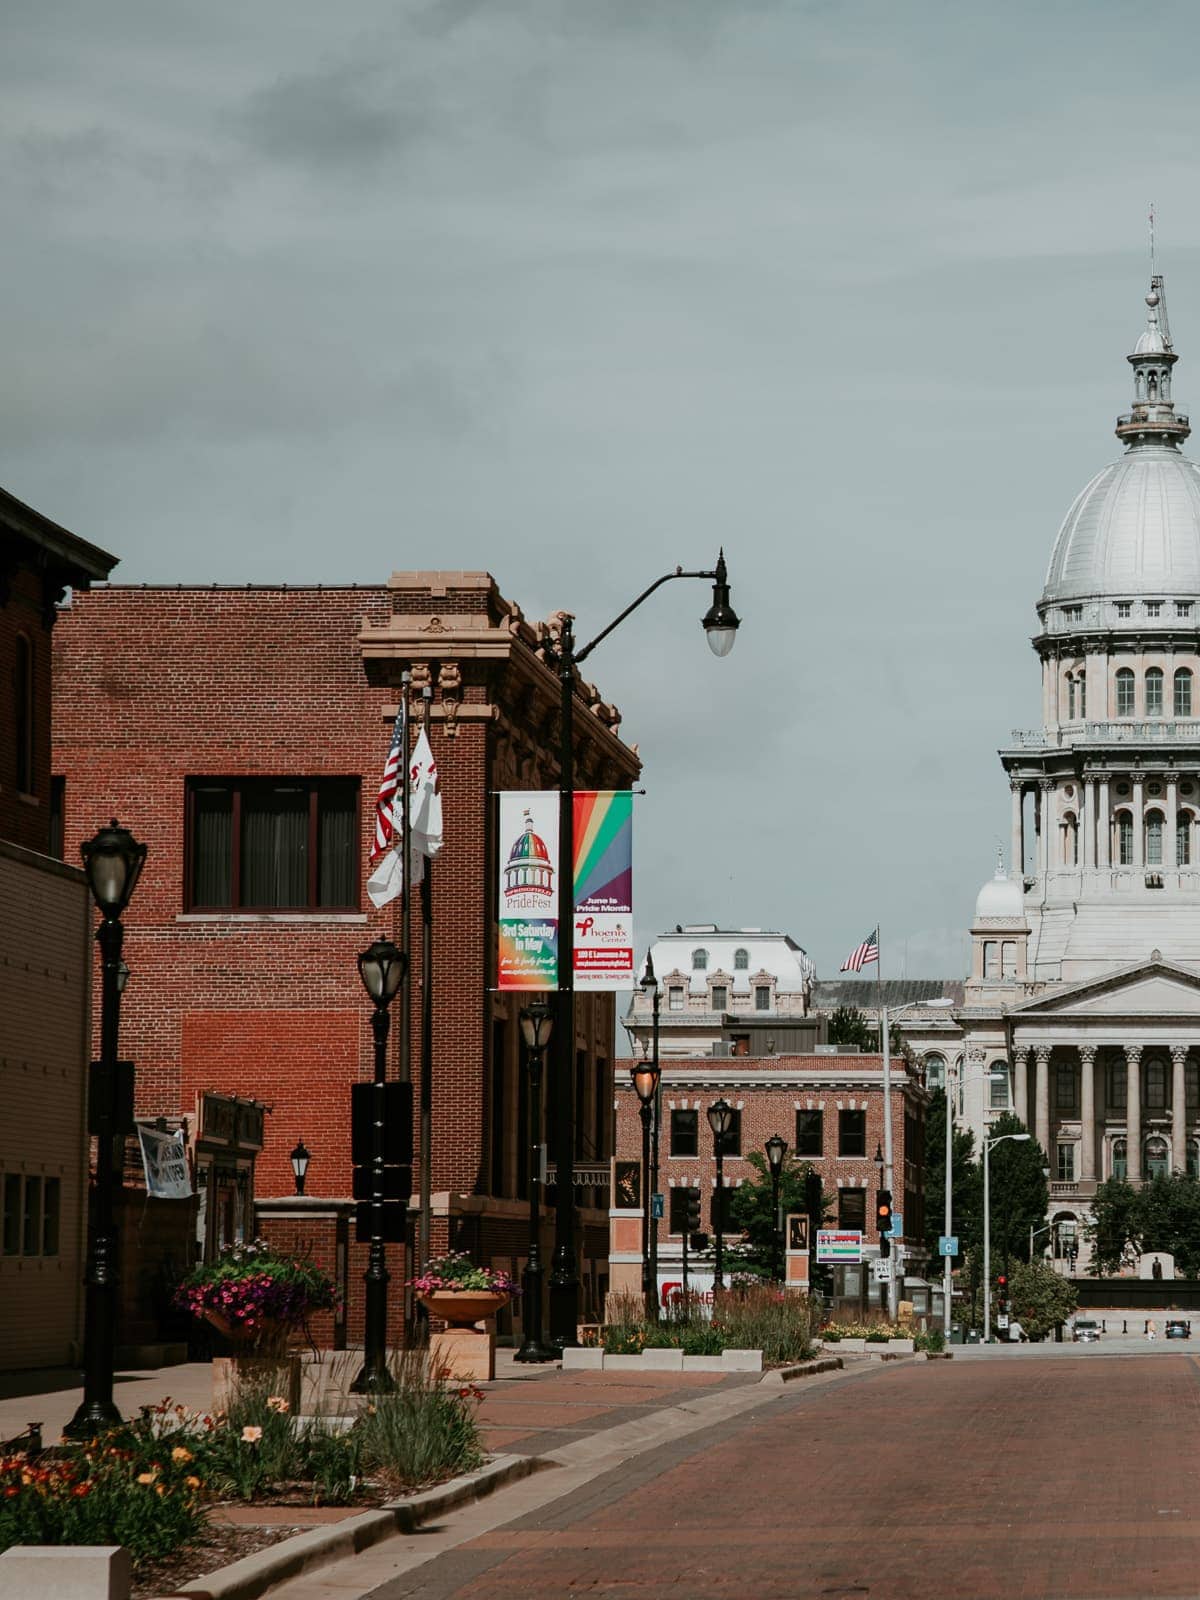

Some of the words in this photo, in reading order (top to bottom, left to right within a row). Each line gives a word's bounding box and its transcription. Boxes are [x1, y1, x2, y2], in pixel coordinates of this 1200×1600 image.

[506, 894, 552, 909] PrideFest
[587, 897, 608, 905] June
[502, 923, 517, 937] 3rd
[518, 923, 556, 940] Saturday
[525, 938, 544, 953] May
